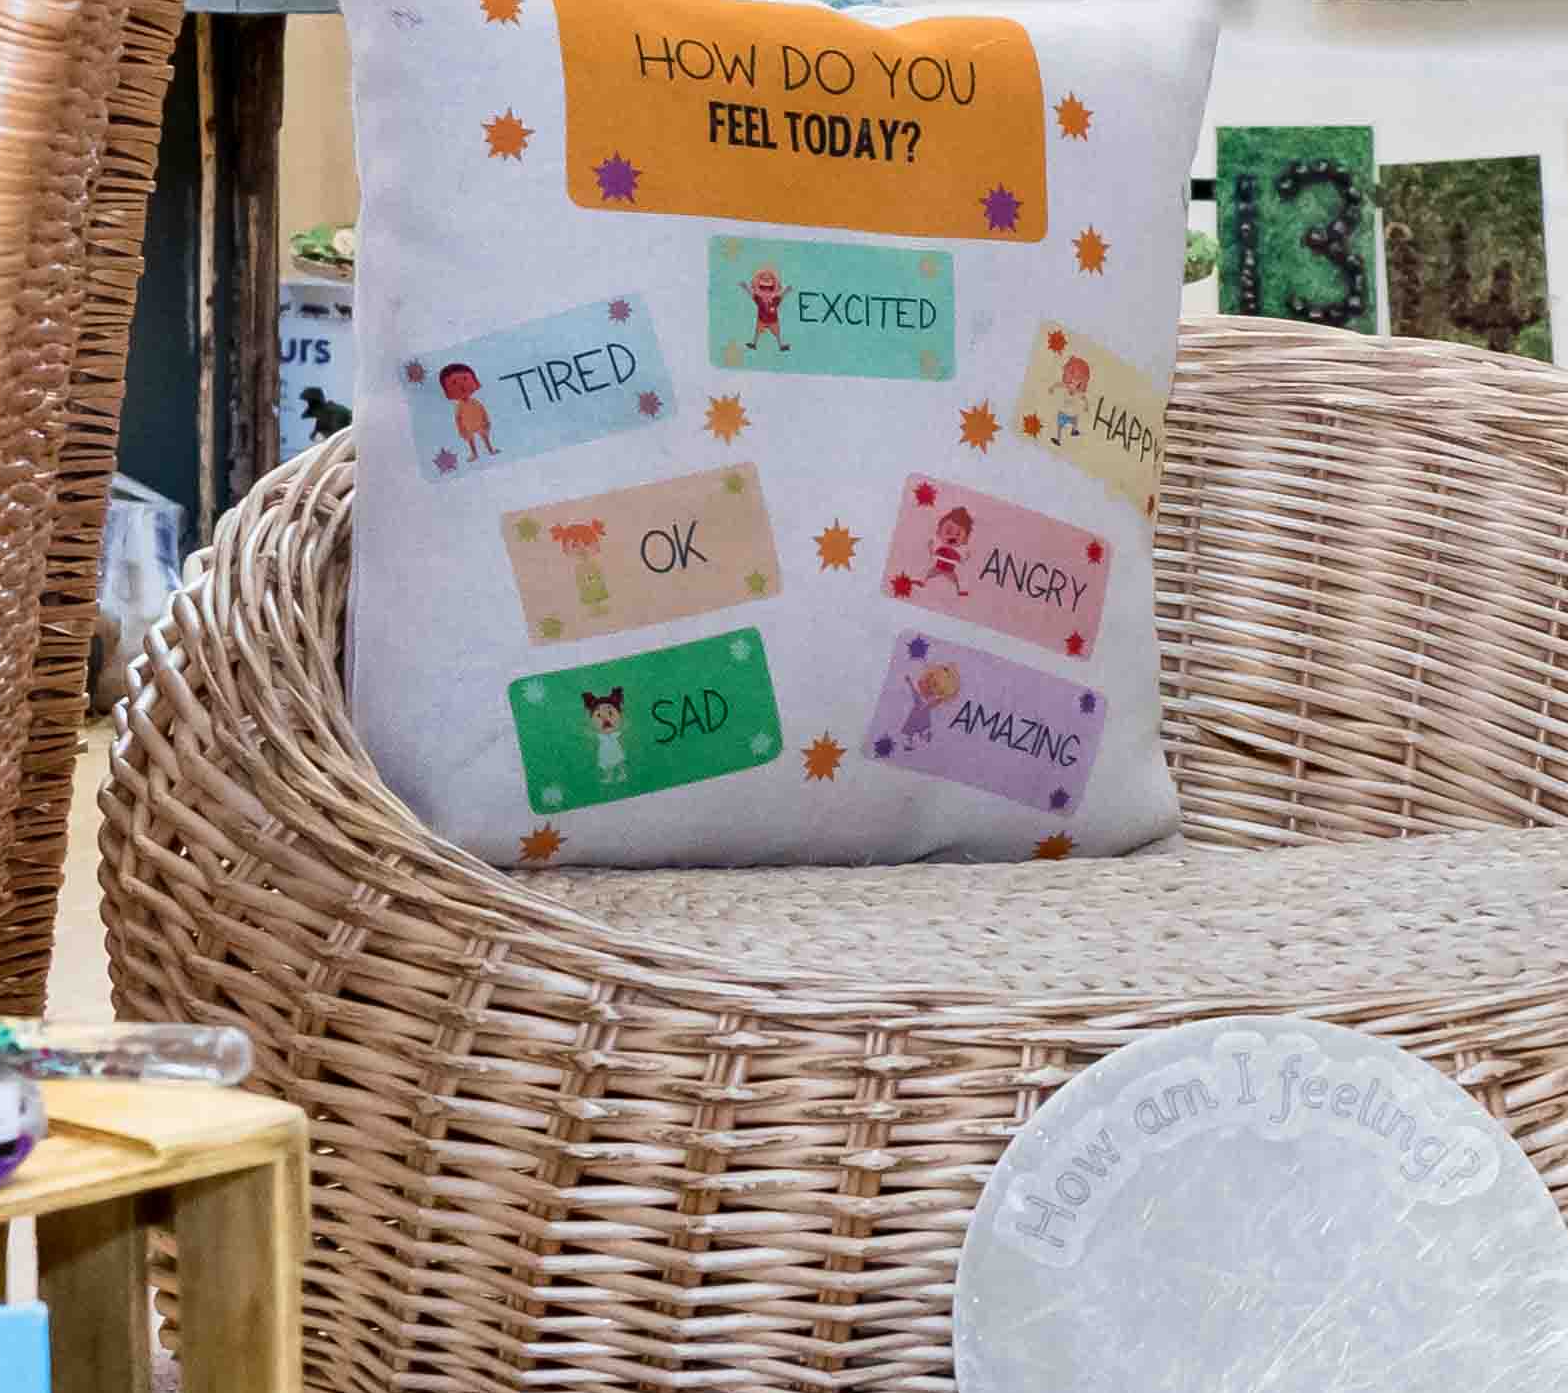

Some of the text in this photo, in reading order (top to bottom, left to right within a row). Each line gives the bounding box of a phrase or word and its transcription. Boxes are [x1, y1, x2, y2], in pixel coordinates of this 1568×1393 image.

[633, 33, 978, 107] HOW DO YOU
[708, 99, 923, 164] FEEL TODAY?
[797, 290, 938, 332] EXCITED
[499, 342, 638, 413] TIRED
[640, 519, 708, 574] OK
[979, 549, 1088, 614] ANGRY
[651, 687, 729, 744] SAD
[947, 698, 1082, 768] AMAZING
[1014, 1052, 1482, 1249] How am I feeling?
